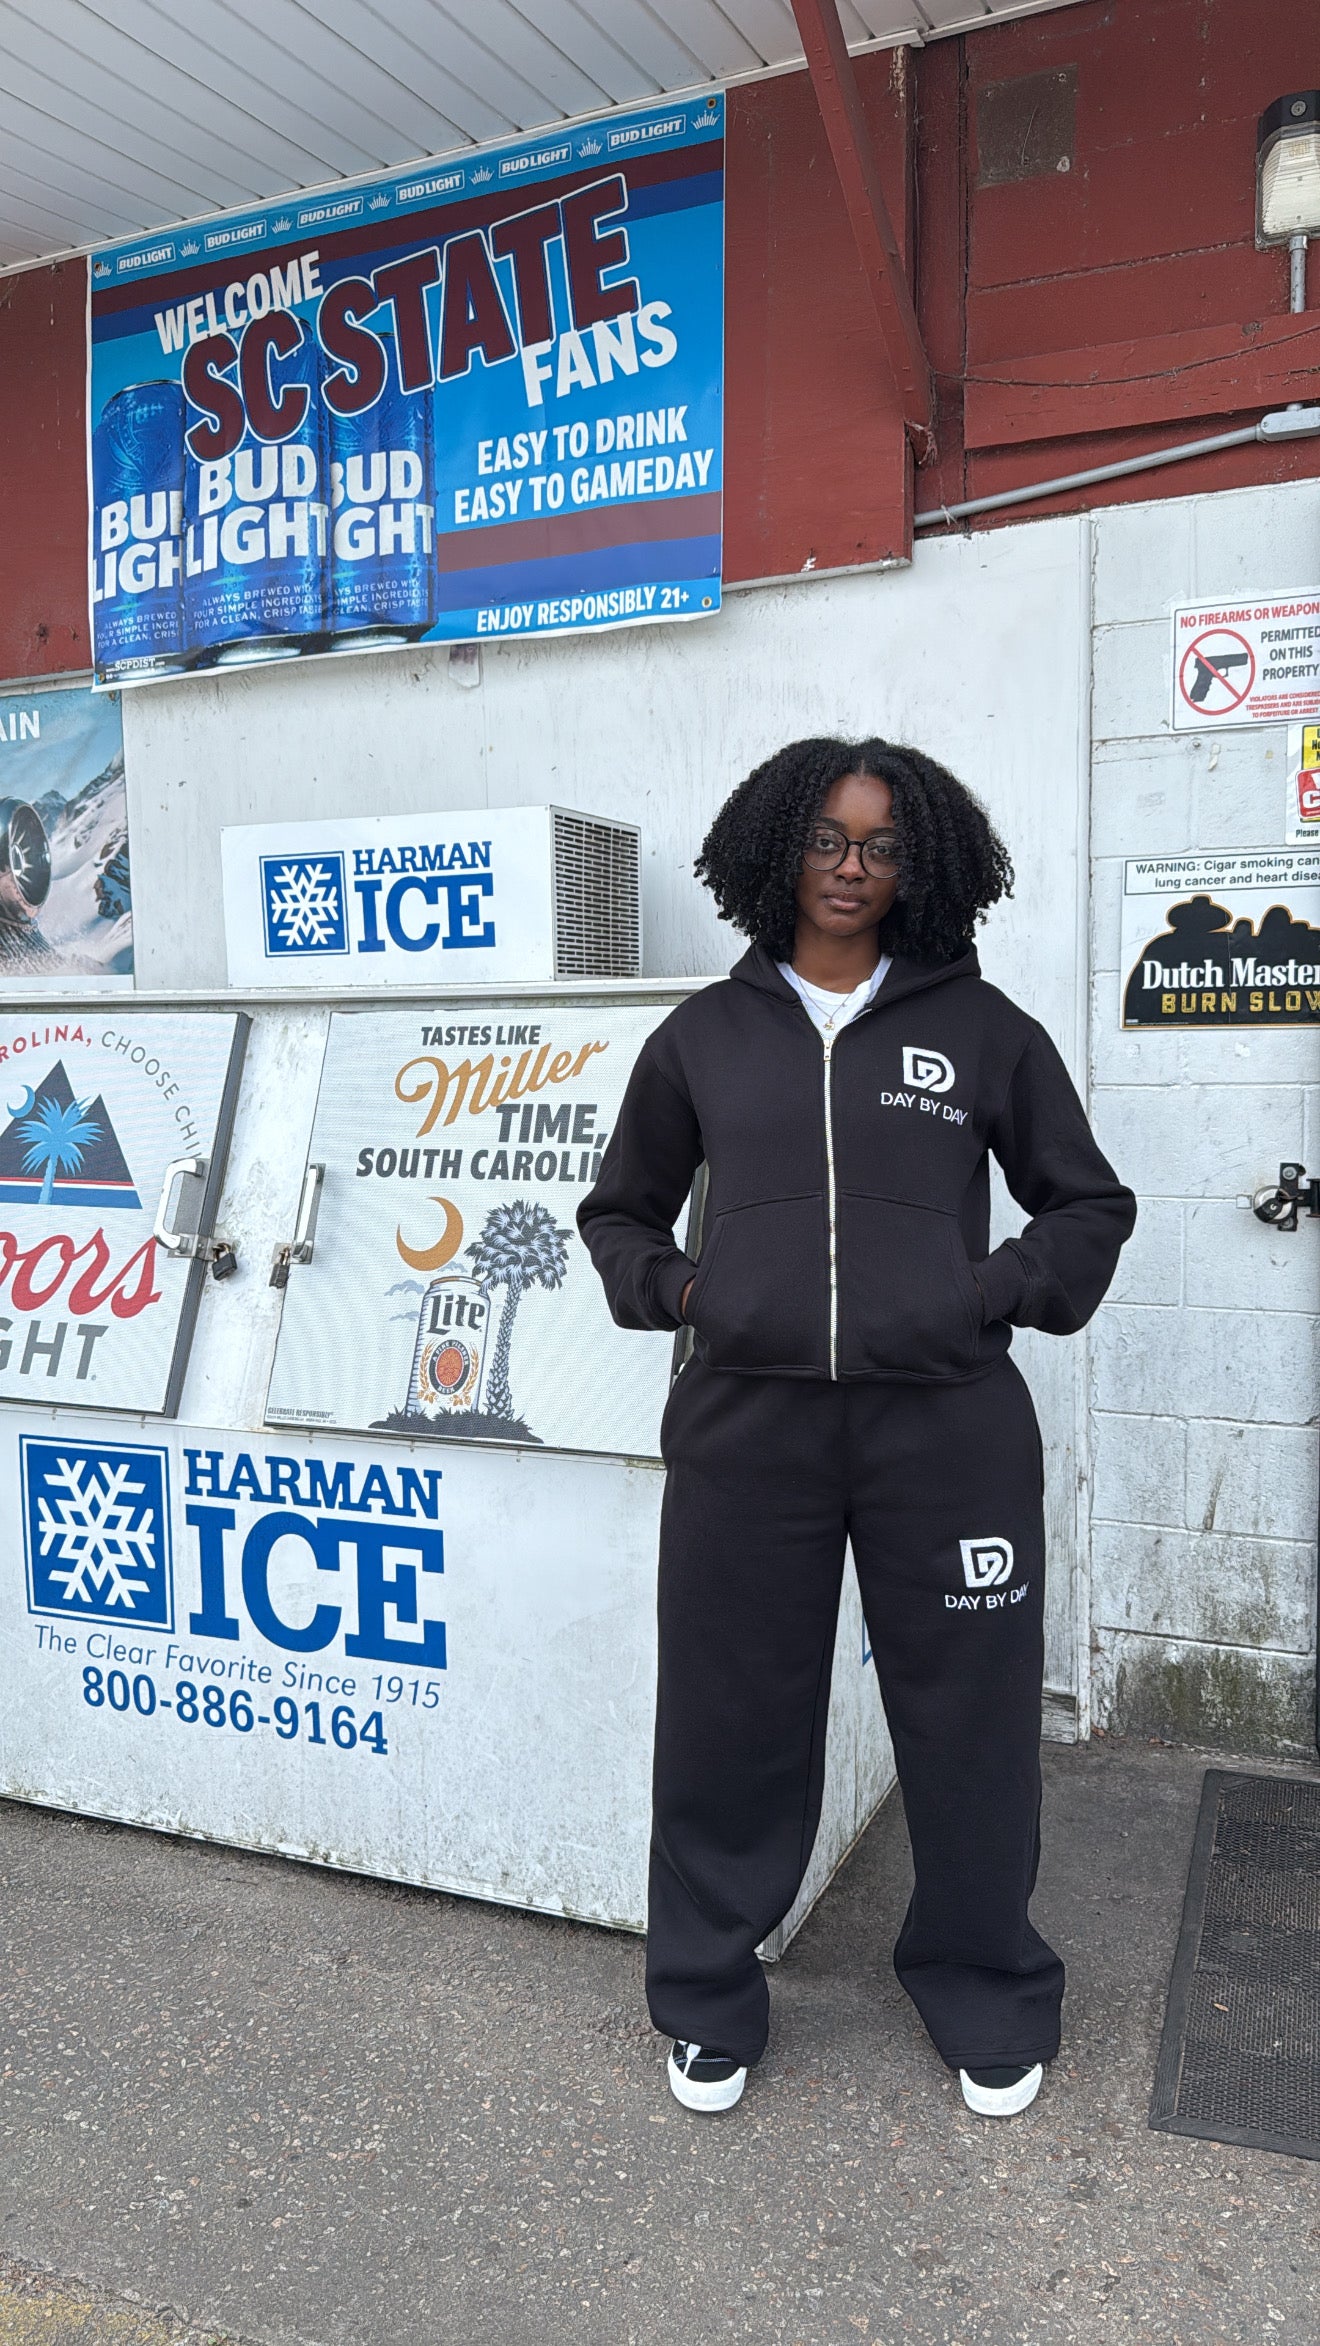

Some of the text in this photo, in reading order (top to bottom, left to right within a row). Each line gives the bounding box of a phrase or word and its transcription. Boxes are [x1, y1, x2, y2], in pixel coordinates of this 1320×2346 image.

[611, 120, 682, 147] BUD LIGHT
[502, 148, 568, 174] BUD LIGHT
[399, 175, 461, 200] BUD LIGHT
[300, 200, 360, 224] BUD LIGHT
[207, 224, 264, 248] BUD LIGHT
[118, 247, 172, 270] BUD LIGHT
[154, 250, 324, 354] WELCOME
[182, 173, 640, 464] SC STATE
[522, 300, 678, 407] FANS
[478, 405, 689, 476] EASY TO DRINK
[199, 445, 317, 516] BUD
[455, 448, 714, 524] EASY TO GAMEDAY
[186, 502, 328, 578] LIGHT
[244, 586, 290, 600] BREWED
[476, 586, 690, 633] ENJOY RESPONSIBLY 21+
[1180, 602, 1320, 628] NO FIREARMS OR WEAPON
[1270, 645, 1313, 661] ON THIS
[1262, 664, 1320, 680] PROPERTY
[1296, 829, 1319, 838] Please
[352, 841, 492, 875] HARMAN
[1136, 856, 1320, 875] WARNING: Cigar smoking can
[1155, 877, 1181, 889] lung
[1184, 876, 1226, 887] cancer
[1229, 873, 1252, 885] and
[1256, 870, 1288, 882] heart
[354, 872, 496, 953] ICE
[1142, 959, 1224, 990] Dutch
[1161, 992, 1237, 1014] BURN
[421, 1025, 542, 1047] TASTES LIKE
[101, 1030, 180, 1101] CHOOSE
[395, 1040, 610, 1139] Miller
[880, 1092, 968, 1126] DAY BY DAY
[496, 1104, 608, 1149] TIME,
[356, 1148, 464, 1180] SOUTH
[426, 1294, 486, 1335] Lite
[183, 1449, 442, 1520] HARMAN
[185, 1503, 448, 1670] ICE
[944, 1581, 1030, 1610] DAY BY DAY
[34, 1624, 440, 1710] The Clear Favorite Since 1915
[82, 1666, 388, 1756] 800-886-9164
